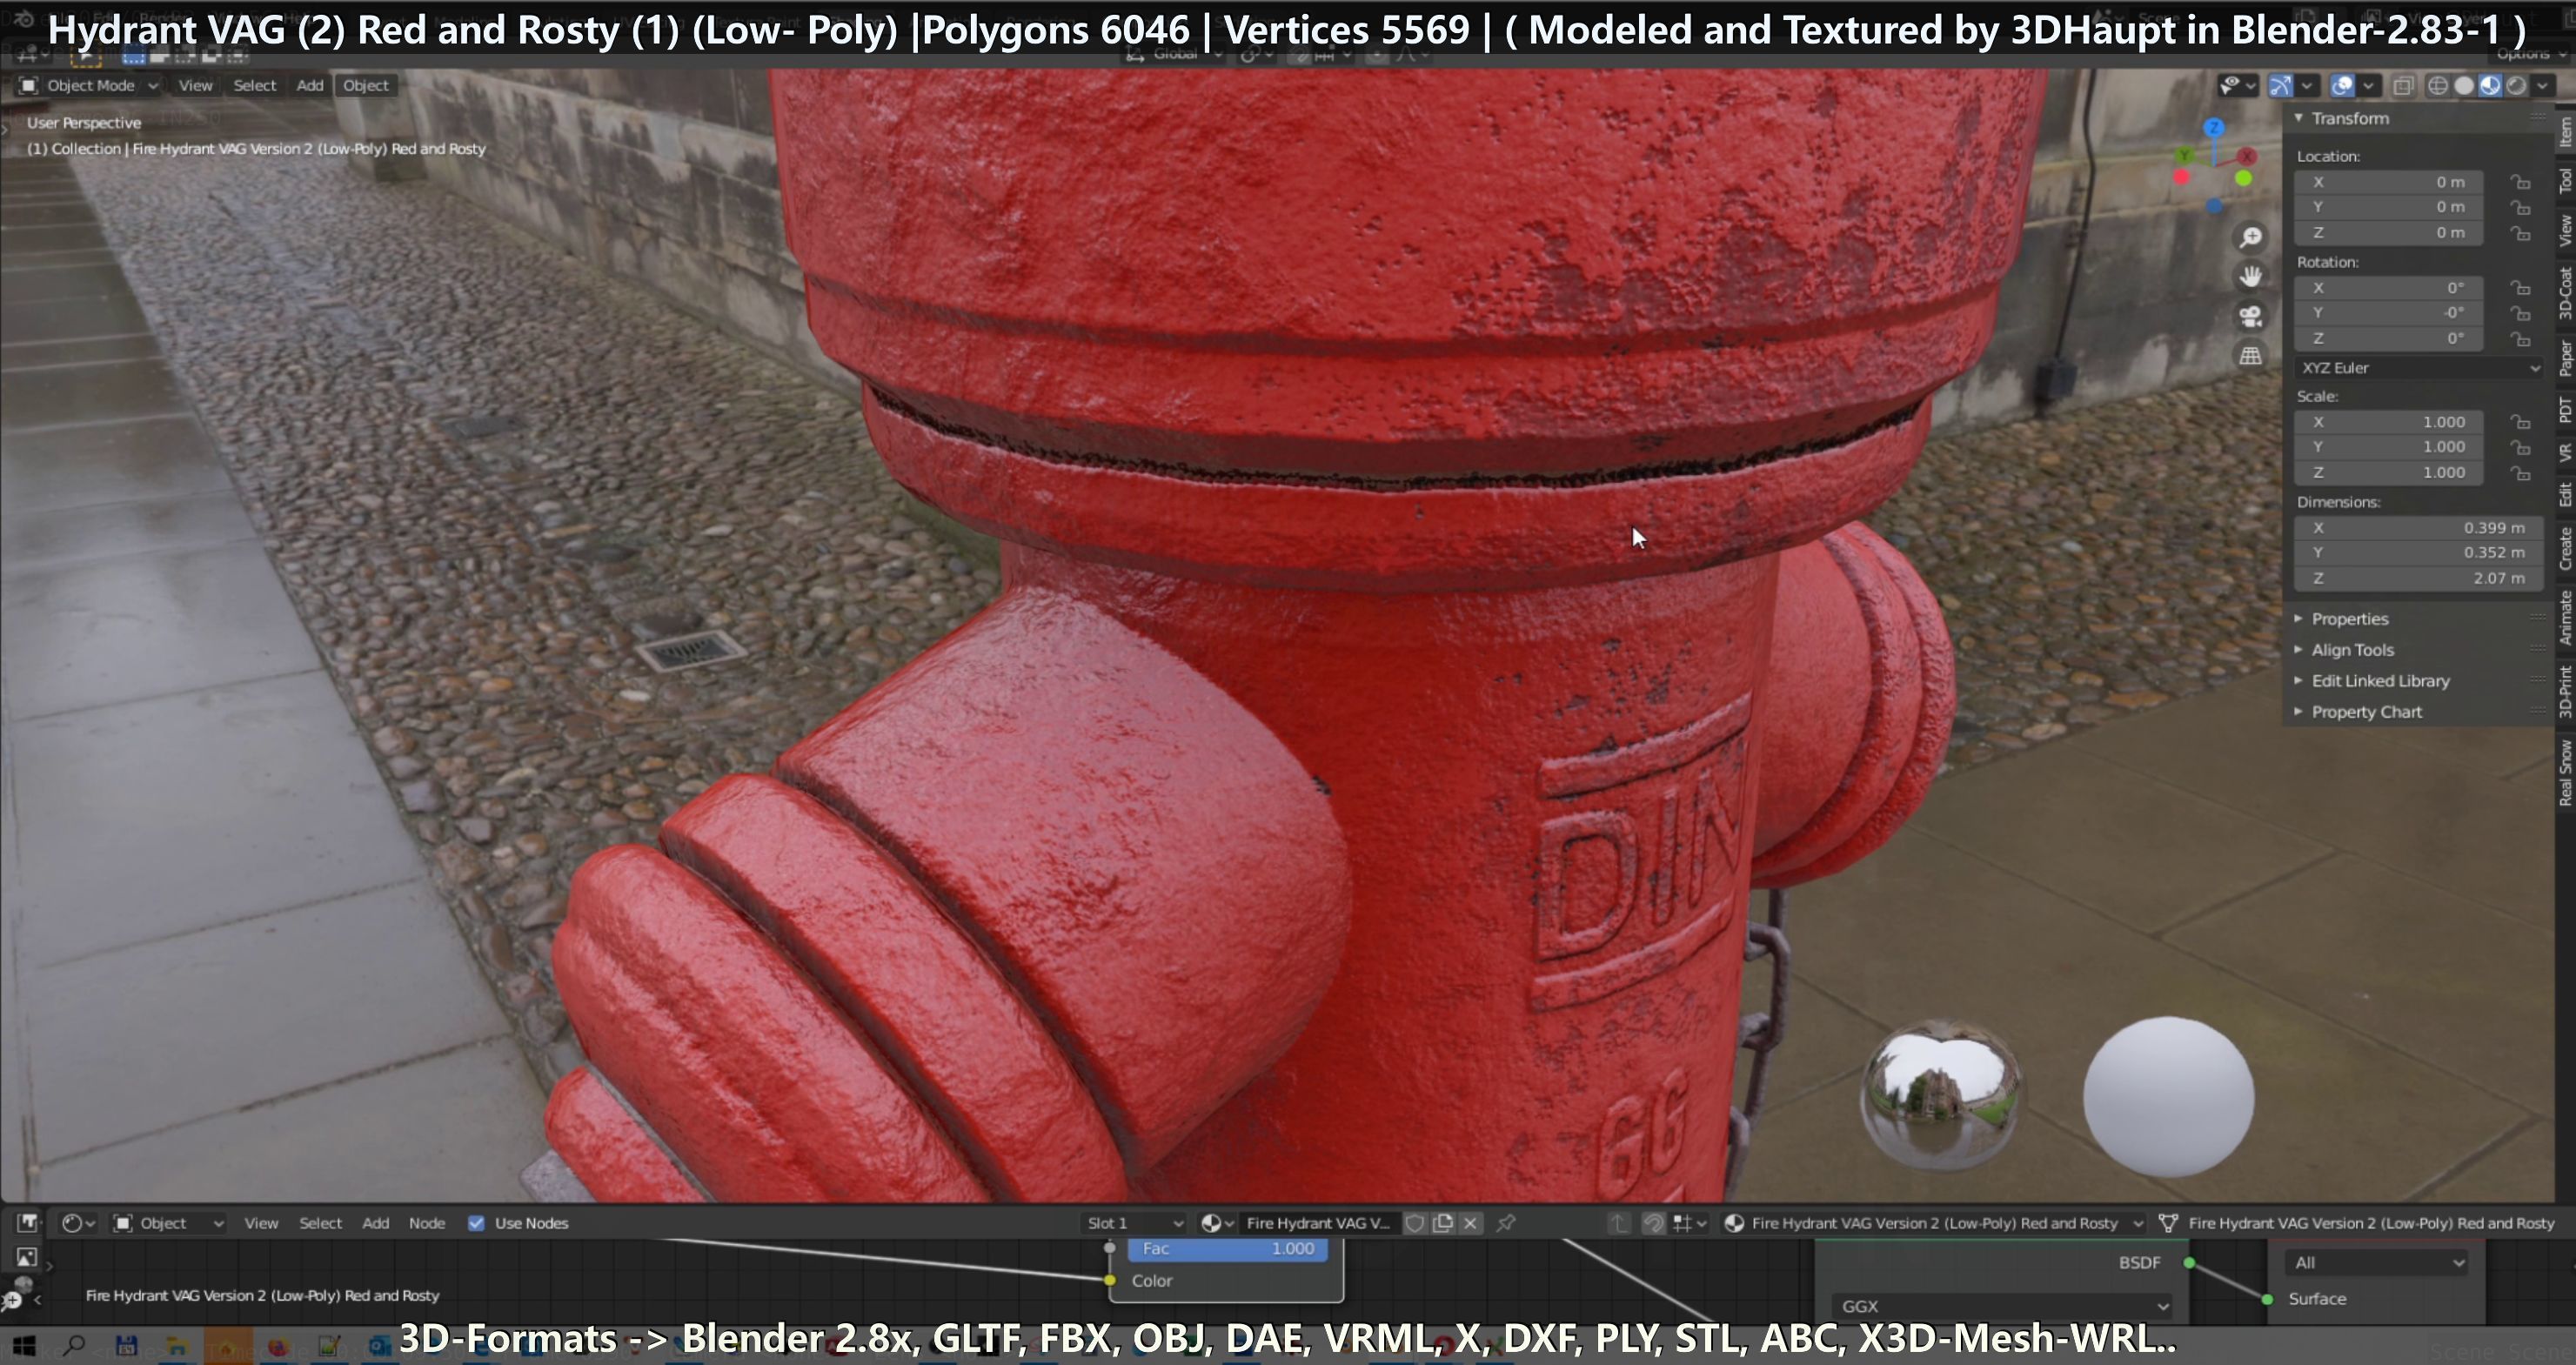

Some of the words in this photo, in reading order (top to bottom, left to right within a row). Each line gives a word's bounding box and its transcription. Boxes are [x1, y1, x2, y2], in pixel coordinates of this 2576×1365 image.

[1154, 47, 1198, 60] Global
[48, 79, 93, 94] Object
[97, 79, 135, 91] Mode
[179, 80, 212, 91] View
[235, 79, 277, 91] Select
[298, 80, 324, 91] Add
[344, 79, 390, 94] Object
[27, 117, 60, 130] User
[64, 117, 142, 131] Perspective
[2312, 111, 2390, 125] Transform
[2559, 117, 2573, 148] Item
[29, 143, 48, 156] (1)
[52, 143, 121, 155] Collection
[133, 143, 157, 155] Fire
[160, 144, 215, 157] Hydrant
[219, 143, 246, 156] VAG
[249, 143, 301, 156] Version
[304, 143, 312, 155] 2
[317, 143, 388, 157] (Low-Poly)
[392, 143, 417, 155] Red
[420, 144, 445, 155] and
[450, 143, 486, 157] Rosty
[2298, 151, 2362, 163] Location:
[2437, 176, 2446, 189] 0
[2451, 178, 2466, 188] m
[2559, 168, 2572, 195] Tool
[2437, 200, 2446, 213] 0
[2451, 203, 2466, 212] m
[2437, 226, 2446, 238] 0
[2451, 229, 2466, 238] m
[2559, 215, 2573, 248] View
[2298, 256, 2359, 269] Rotation:
[2559, 266, 2572, 320] 3D-Coat
[2559, 339, 2575, 377] Paper
[2303, 362, 2331, 374] XYZ
[2335, 362, 2370, 374] Euler
[2298, 391, 2338, 403] Scale:
[2559, 396, 2572, 423] PDT
[2424, 416, 2466, 428] 1.000
[2424, 440, 2466, 453] 1.000
[2559, 443, 2572, 463] VR
[2424, 466, 2466, 478] 1.000
[2559, 482, 2572, 507] Edit
[2298, 496, 2380, 508] Dimensions:
[2464, 521, 2506, 534] 0.399
[2511, 525, 2526, 534] m
[2464, 546, 2506, 559] 0.352
[2511, 549, 2526, 559] m
[2559, 527, 2572, 571] Create
[2474, 572, 2506, 585] 2.07
[2511, 574, 2526, 585] m
[2312, 612, 2390, 629] Properties
[2559, 590, 2573, 646] Animate
[2312, 643, 2352, 660] Align
[2354, 643, 2395, 657] Tools
[2312, 674, 2343, 687] Edit
[2345, 674, 2395, 688] Linked
[2399, 674, 2451, 691] Library
[2559, 665, 2572, 719] 3D-Print
[2312, 705, 2377, 722] Property
[2380, 705, 2423, 719] Chart
[2559, 739, 2573, 774] Snow
[2559, 779, 2573, 806] Real
[1534, 759, 1743, 962] DIN
[141, 1217, 187, 1232] Object
[244, 1217, 278, 1229] View
[299, 1217, 343, 1229] Select
[362, 1217, 390, 1229] Add
[410, 1217, 446, 1229] Node
[495, 1217, 523, 1229] Use
[526, 1217, 569, 1229] Nodes
[1088, 1217, 1114, 1229] Slot
[1120, 1217, 1127, 1229] 1
[1248, 1217, 1275, 1229] Fire
[1278, 1217, 1333, 1232] Hydrant
[1336, 1217, 1367, 1229] VAG
[1753, 1217, 1779, 1229] Fire
[1783, 1217, 1837, 1232] Hydrant
[1842, 1217, 1872, 1229] VAG
[1876, 1217, 1928, 1229] Version
[1930, 1217, 1939, 1229] 2
[1944, 1217, 2017, 1232] (Low-Poly)
[2021, 1217, 2048, 1229] Red
[2051, 1217, 2077, 1229] and
[2080, 1217, 2118, 1232] Rosty
[2189, 1217, 2216, 1229] Fire
[2219, 1217, 2275, 1232] Hydrant
[2278, 1217, 2309, 1229] VAG
[2312, 1218, 2364, 1229] Version
[2367, 1217, 2376, 1229] 2
[2381, 1217, 2453, 1232] (Low-Poly)
[2458, 1217, 2485, 1229] Red
[2488, 1217, 2513, 1229] and
[2517, 1217, 2555, 1232] Rosty
[1144, 1242, 1168, 1255] Fac
[1274, 1242, 1314, 1255] 1.000
[2119, 1255, 2161, 1269] BSDF
[2295, 1256, 2315, 1269] All
[1132, 1274, 1173, 1288] Color
[86, 1289, 110, 1301] Fire
[113, 1289, 169, 1304] Hydrant
[172, 1289, 200, 1301] VAG
[204, 1289, 254, 1301] Version
[258, 1289, 266, 1301] 2
[271, 1289, 341, 1304] (Low-Poly)
[345, 1289, 371, 1301] Red
[374, 1289, 399, 1301] and
[403, 1289, 440, 1304] Rosty
[2289, 1292, 2347, 1306] Surface
[1843, 1300, 1878, 1313] GGX
